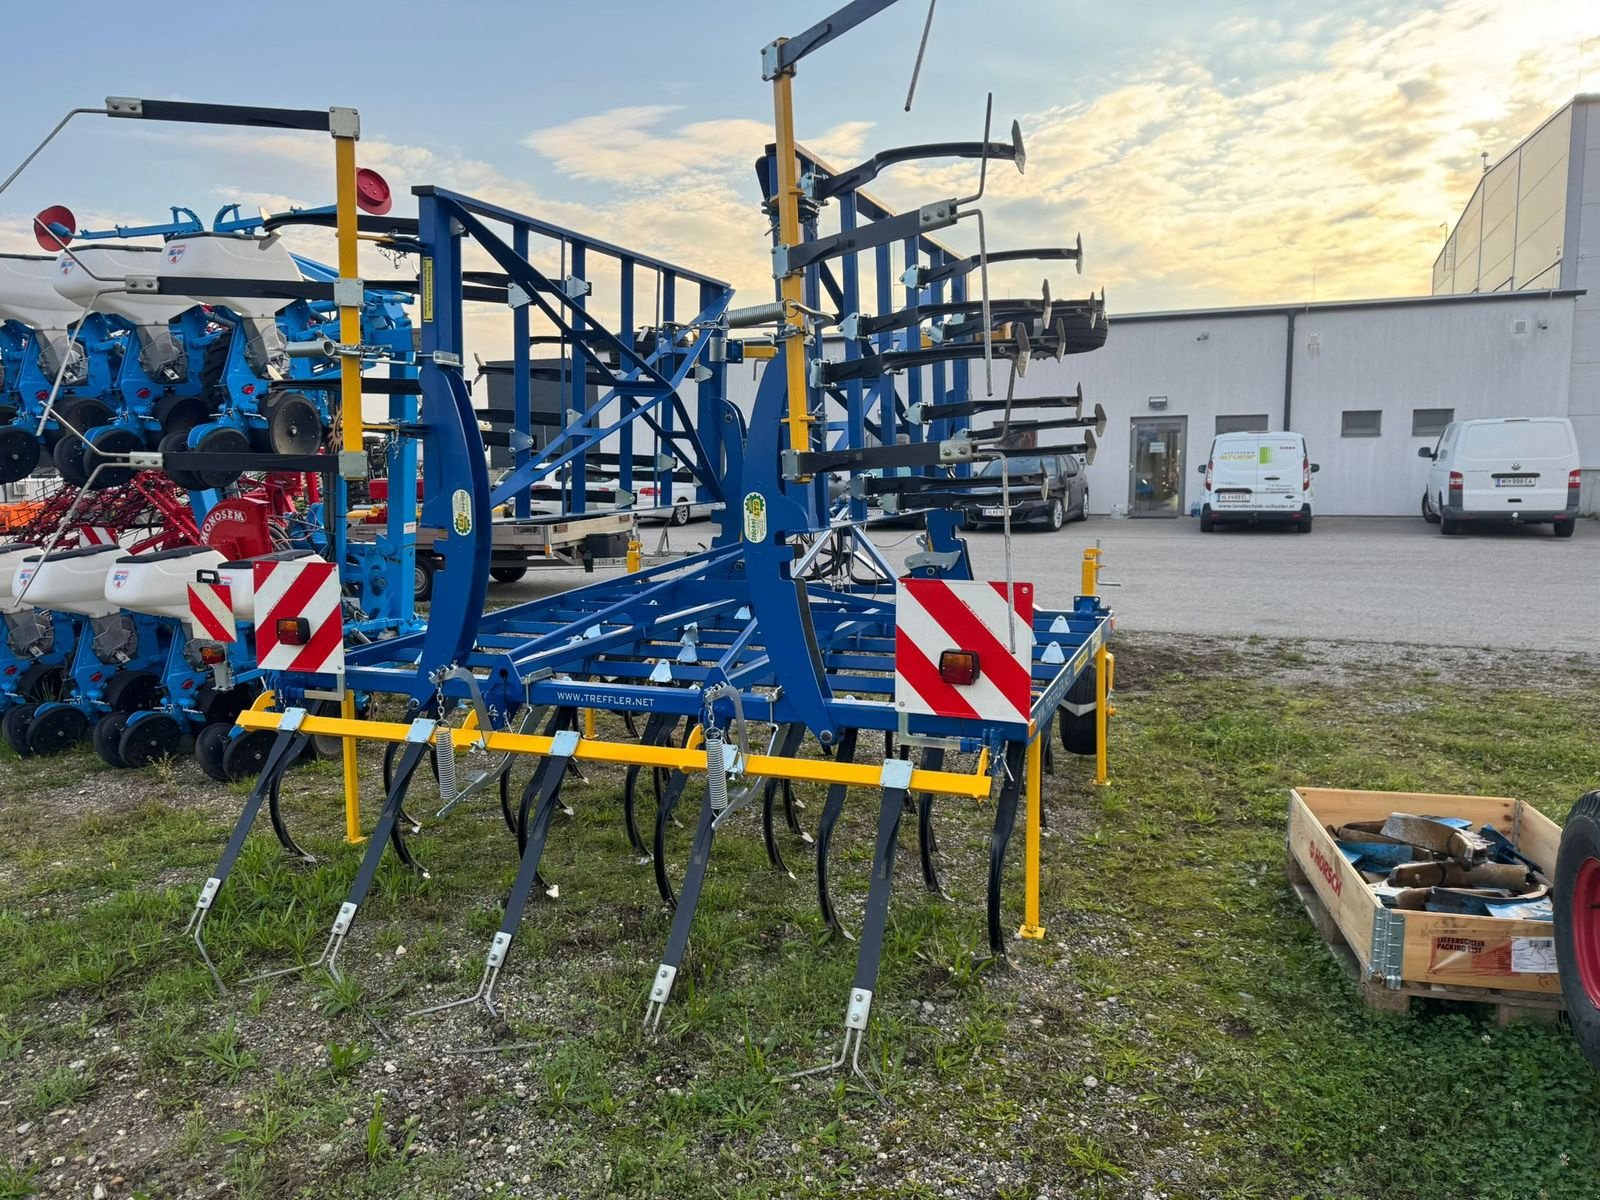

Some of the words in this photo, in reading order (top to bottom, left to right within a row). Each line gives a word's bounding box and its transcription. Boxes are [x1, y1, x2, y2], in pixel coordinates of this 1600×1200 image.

[201, 511, 244, 544] MONOSEM
[556, 691, 655, 707] WWW.TREFFLER.NET
[1314, 847, 1342, 897] HORSCH
[1437, 937, 1485, 946] LIEFERSCHEIN
[1437, 943, 1466, 952] PACKING
[1467, 945, 1482, 953] LIST
